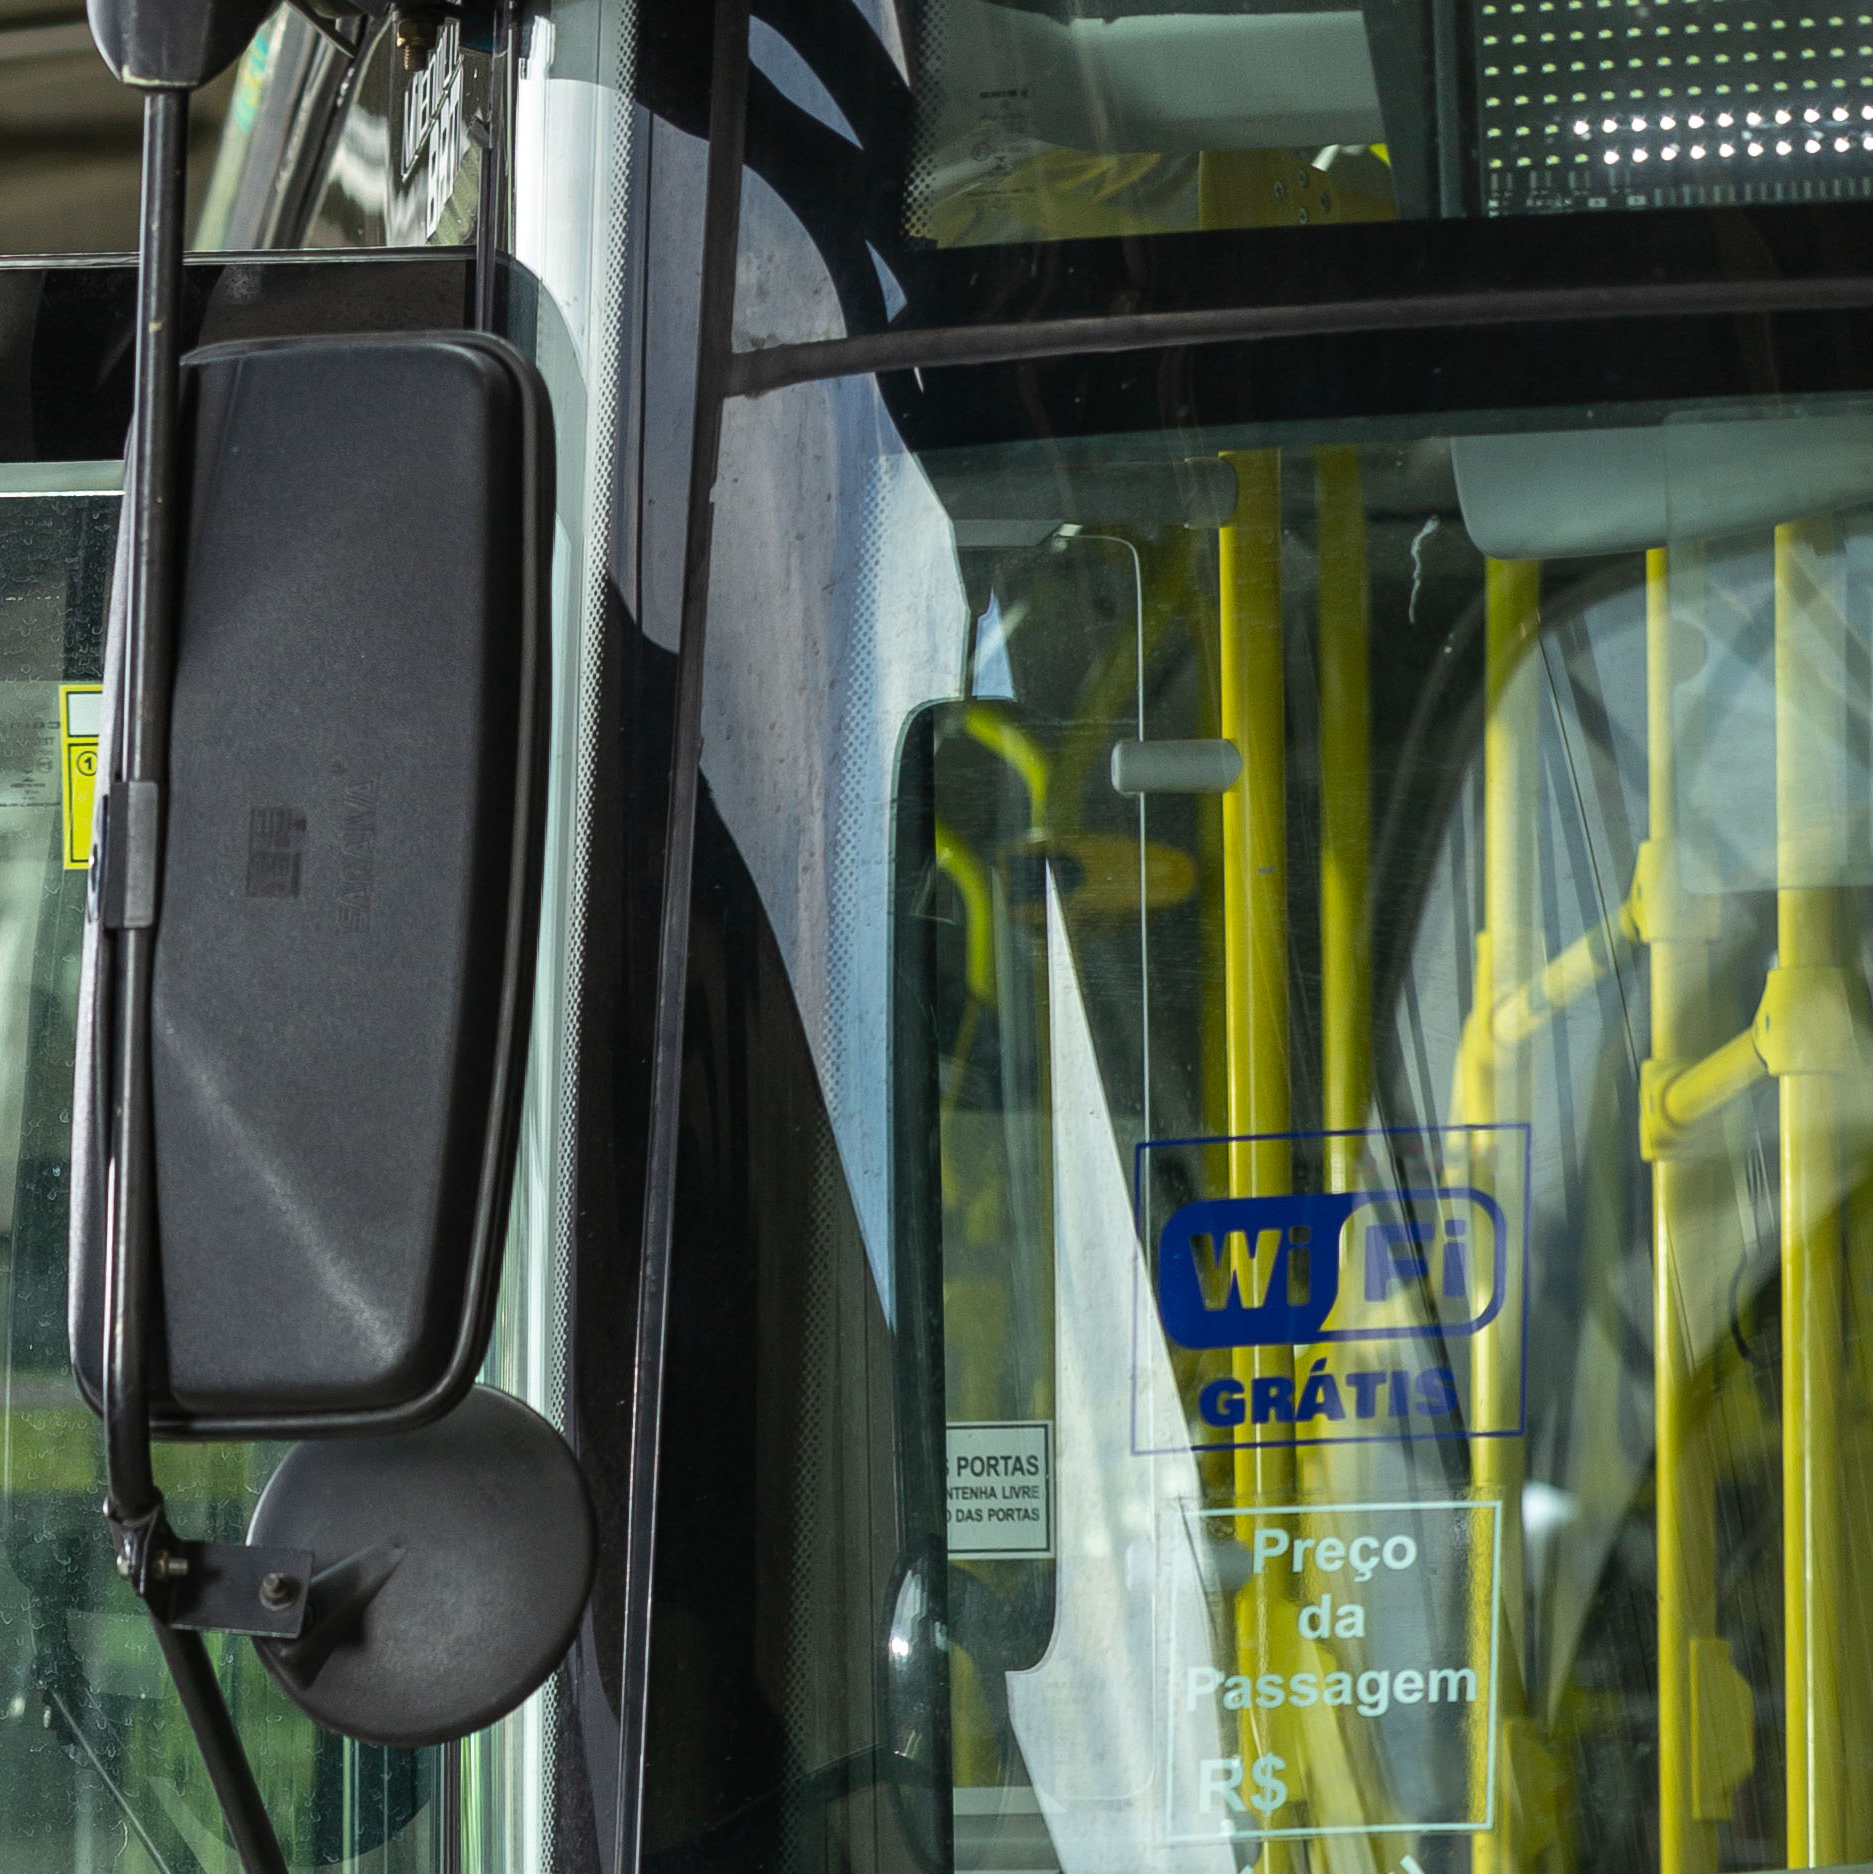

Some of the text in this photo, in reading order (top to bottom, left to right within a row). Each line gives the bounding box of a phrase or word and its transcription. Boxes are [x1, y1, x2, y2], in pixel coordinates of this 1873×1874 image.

[1198, 1357, 1459, 1427] GRÁTIS
[956, 1454, 1040, 1477] PORTAS
[956, 1508, 983, 1522] DAS
[988, 1507, 1040, 1522] PORTAS
[1002, 1485, 1040, 1500] LIVRE
[1253, 1528, 1417, 1582] Preço
[1298, 1594, 1366, 1640] da
[1186, 1666, 1478, 1717] Passagem
[1199, 1752, 1288, 1817] R$
